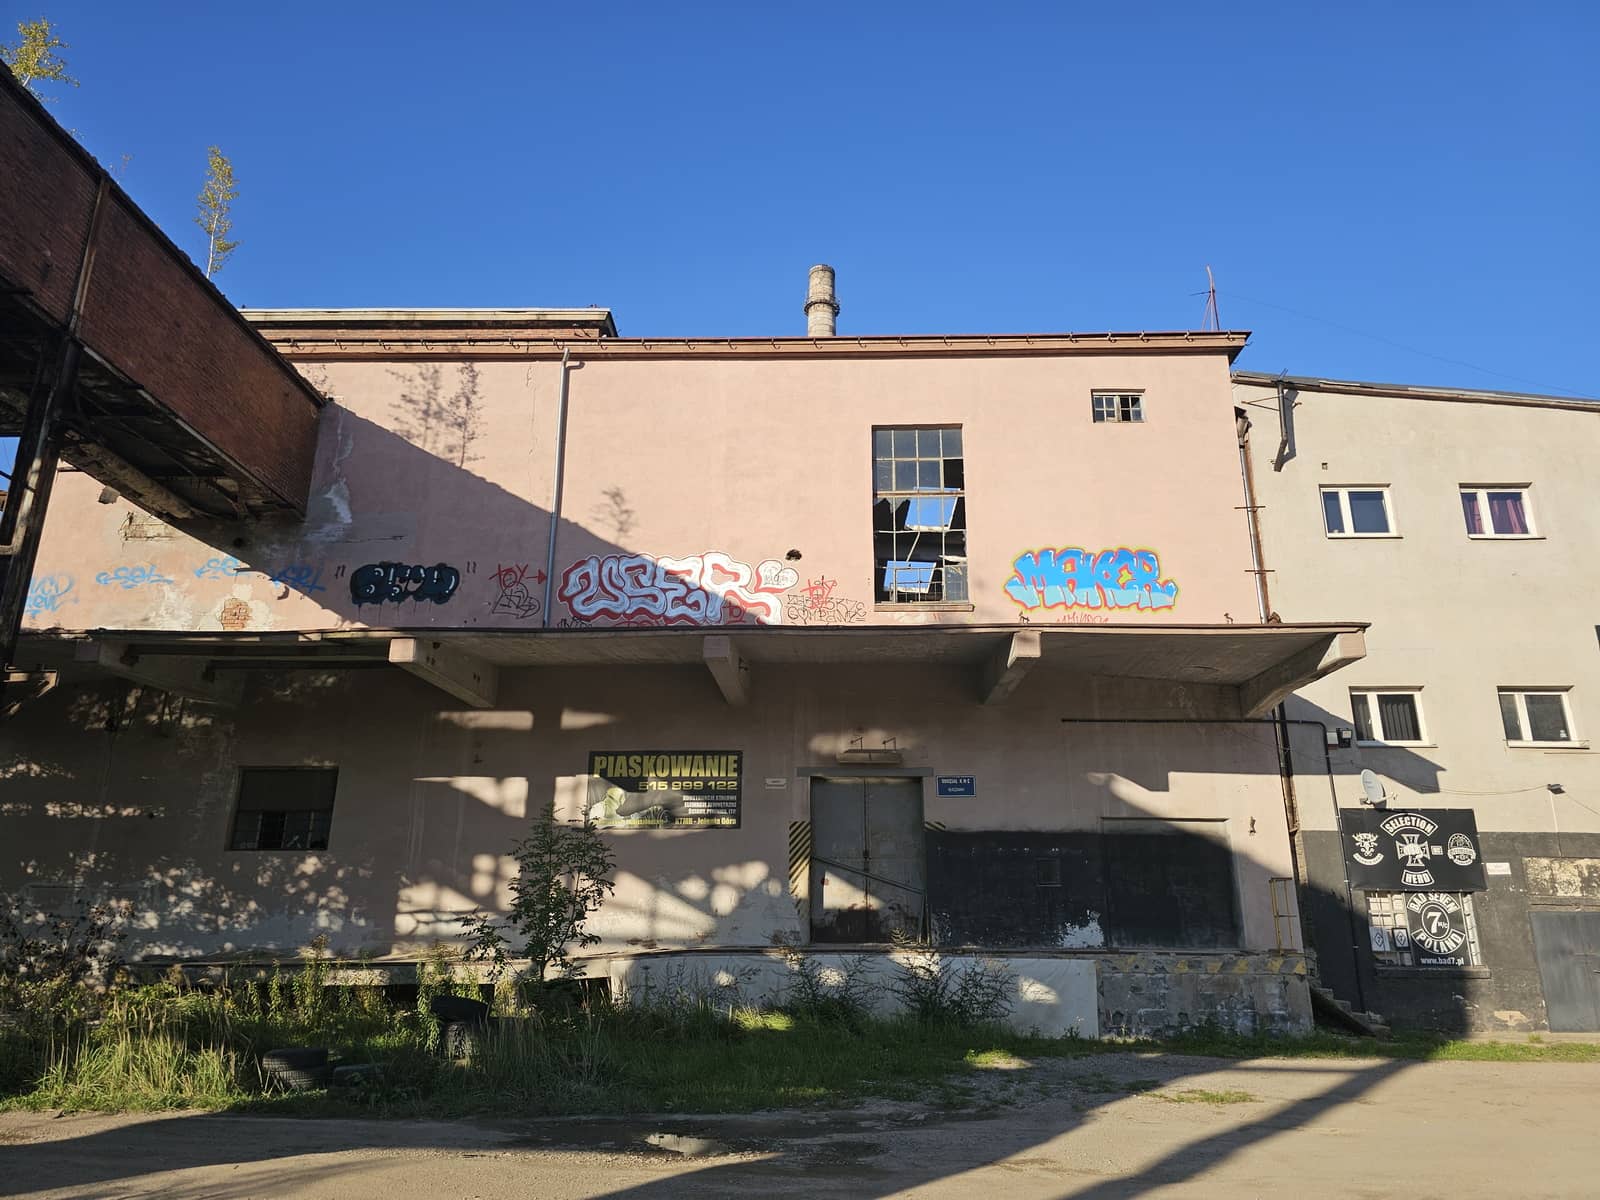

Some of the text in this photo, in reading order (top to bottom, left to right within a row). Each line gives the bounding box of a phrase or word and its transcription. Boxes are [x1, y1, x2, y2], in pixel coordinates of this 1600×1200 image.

[593, 755, 738, 778] PIASKOWANIE
[639, 781, 737, 790] 515 999 122
[1384, 816, 1434, 833] SELECTION
[1409, 893, 1427, 912] BAD
[1426, 911, 1442, 934] 7
[1415, 932, 1462, 953] POLAND
